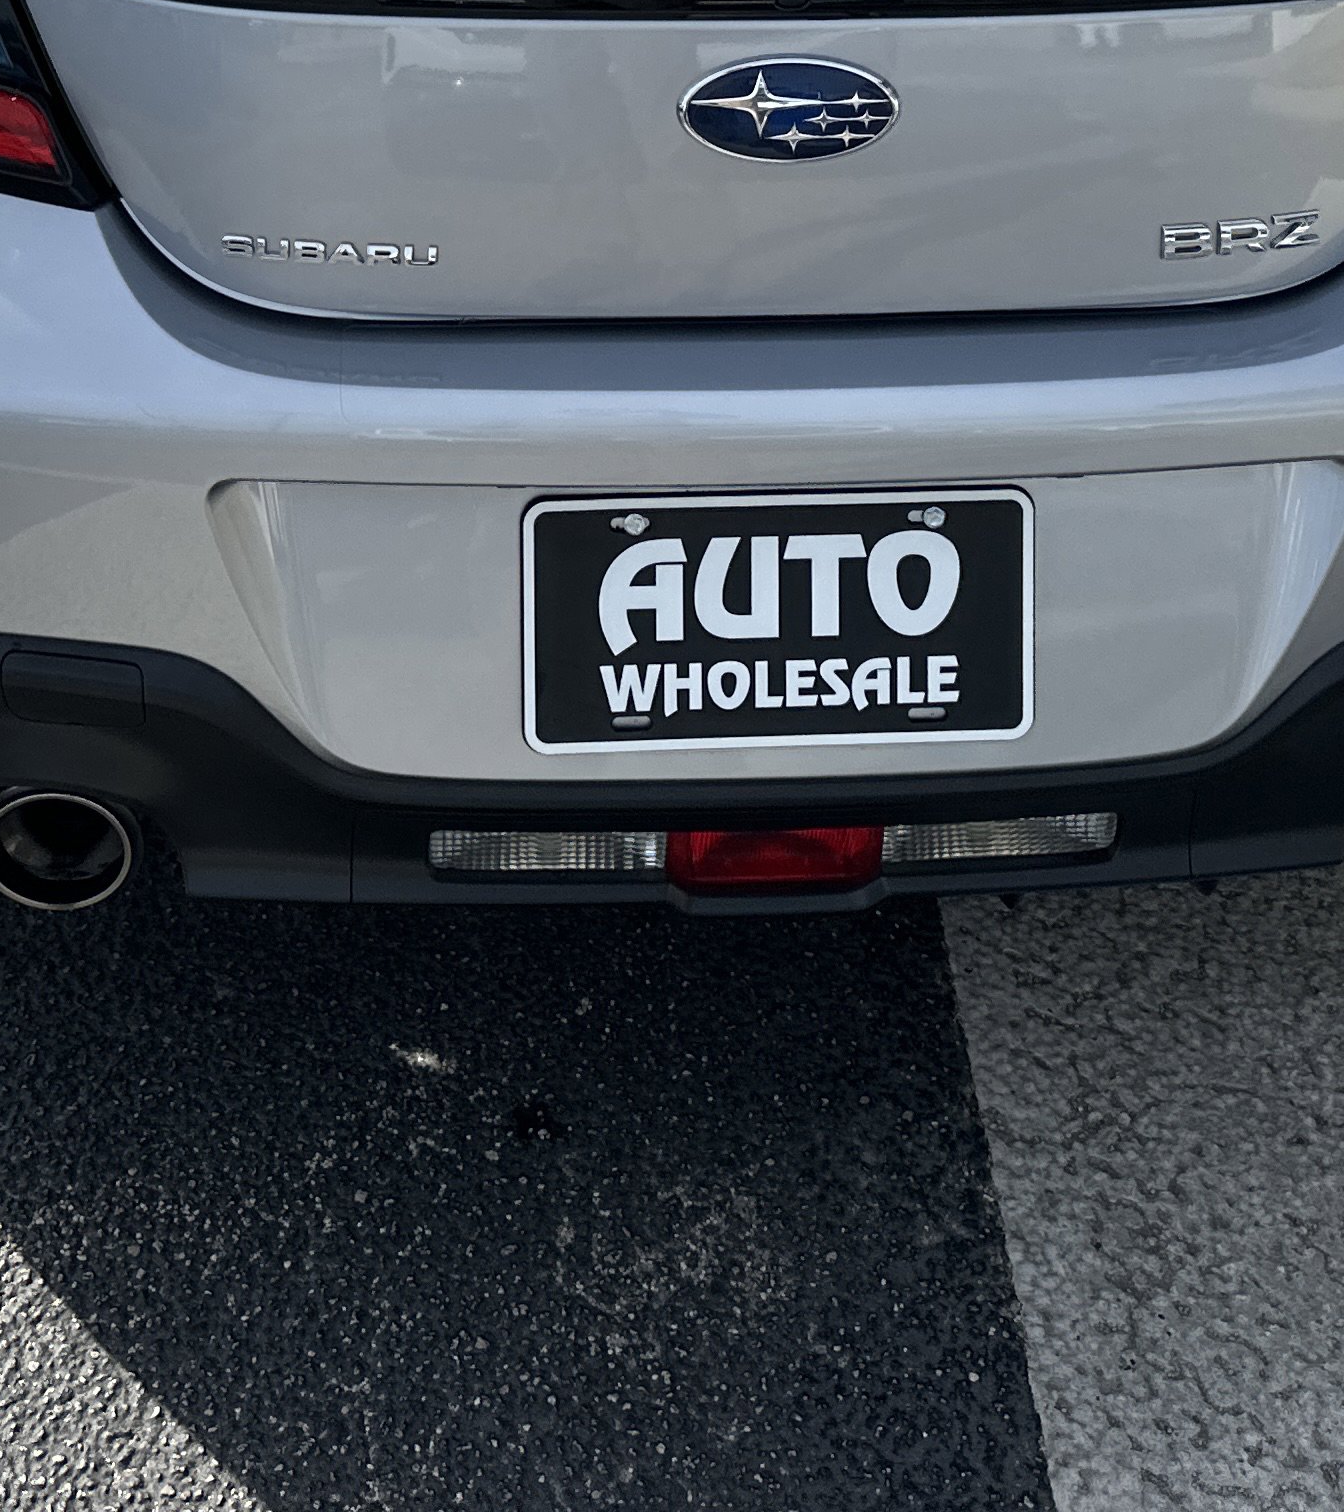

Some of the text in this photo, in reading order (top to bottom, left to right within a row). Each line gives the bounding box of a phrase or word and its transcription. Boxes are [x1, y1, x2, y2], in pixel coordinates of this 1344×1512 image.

[221, 234, 439, 267] SUBARU
[1159, 208, 1320, 260] BRZ
[598, 529, 961, 656] AUTO
[599, 654, 960, 717] WHOLESALE
